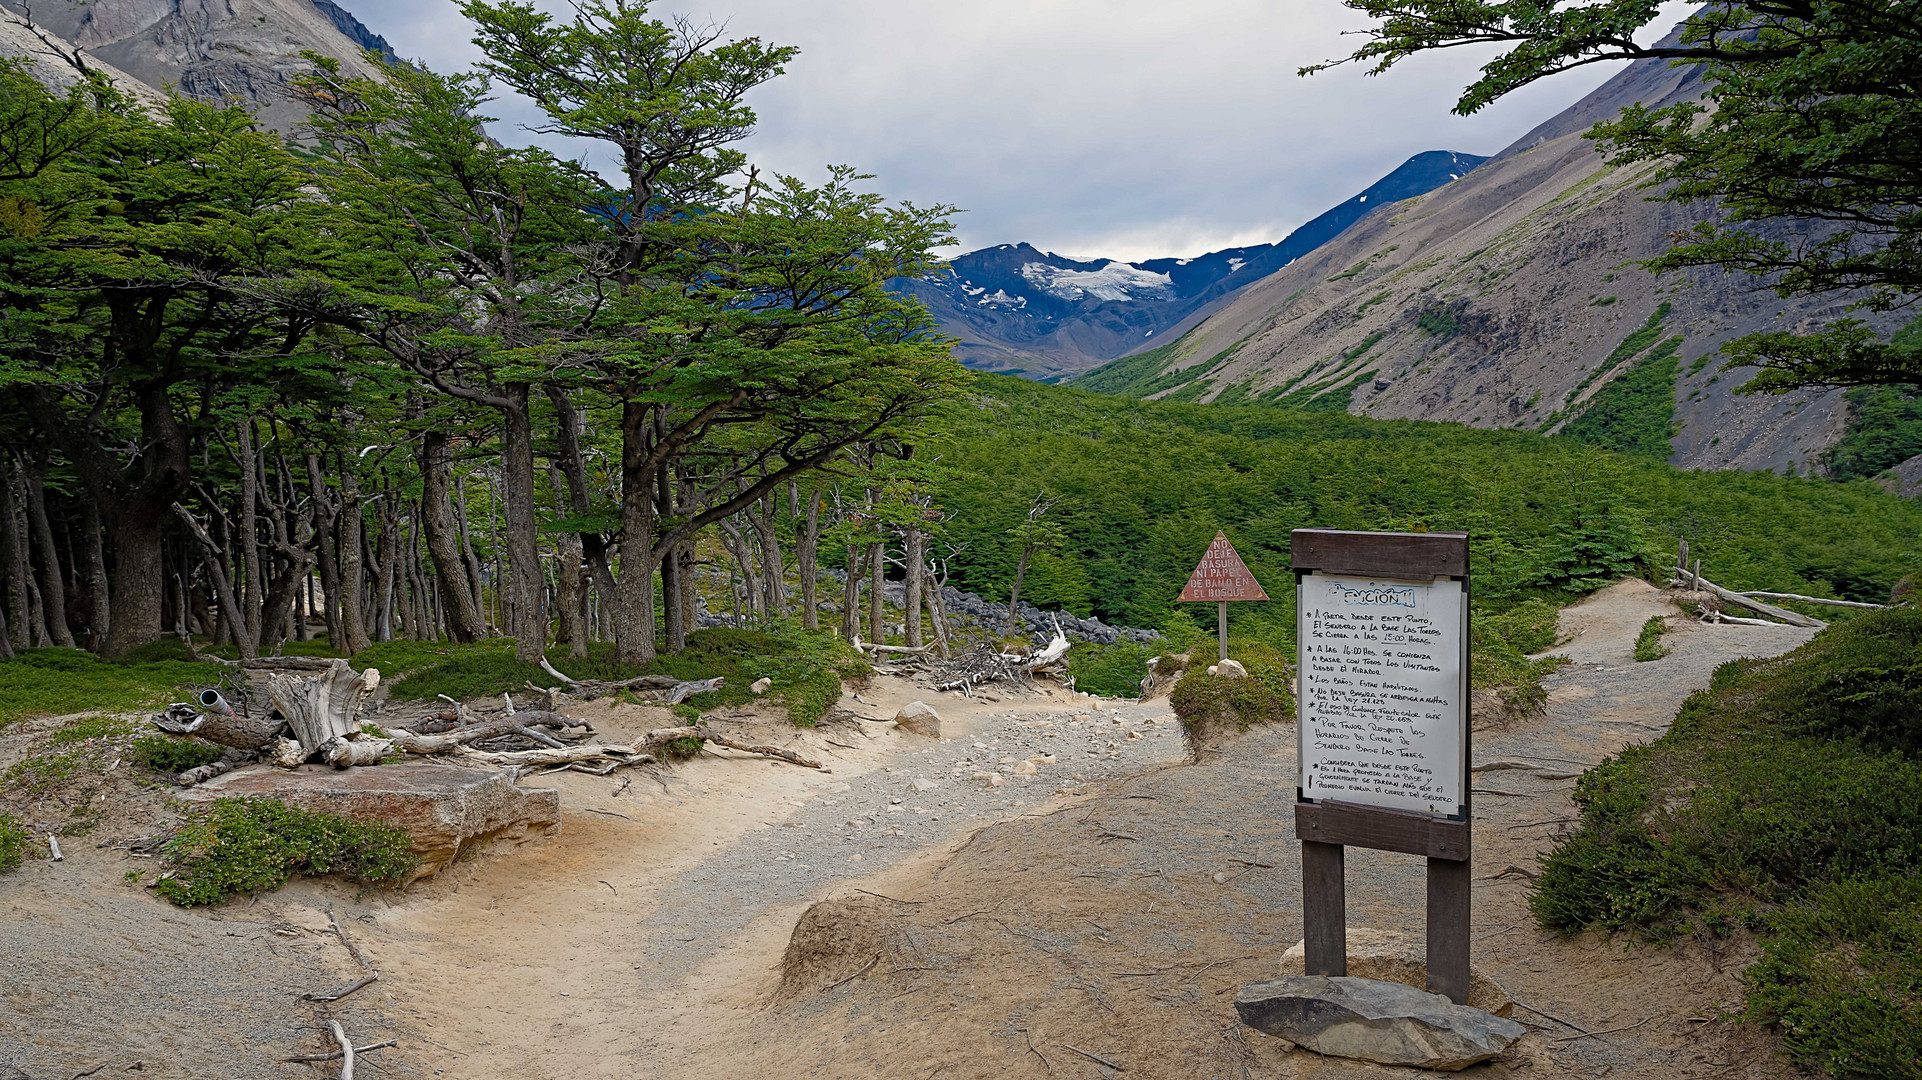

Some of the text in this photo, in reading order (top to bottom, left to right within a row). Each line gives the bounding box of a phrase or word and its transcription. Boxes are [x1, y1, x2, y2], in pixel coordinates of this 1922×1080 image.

[1213, 540, 1228, 549] NO
[1207, 549, 1232, 558] DEJE
[1202, 559, 1240, 569] BASURA
[1196, 569, 1207, 578] NI
[1190, 579, 1202, 588] DE
[1236, 578, 1249, 586] EN
[1194, 588, 1246, 598] EL BOSQUE
[1351, 612, 1374, 620] DESDE
[1324, 622, 1356, 630] SENDERO
[1382, 624, 1400, 632] BASE
[1384, 633, 1404, 642] 15:00
